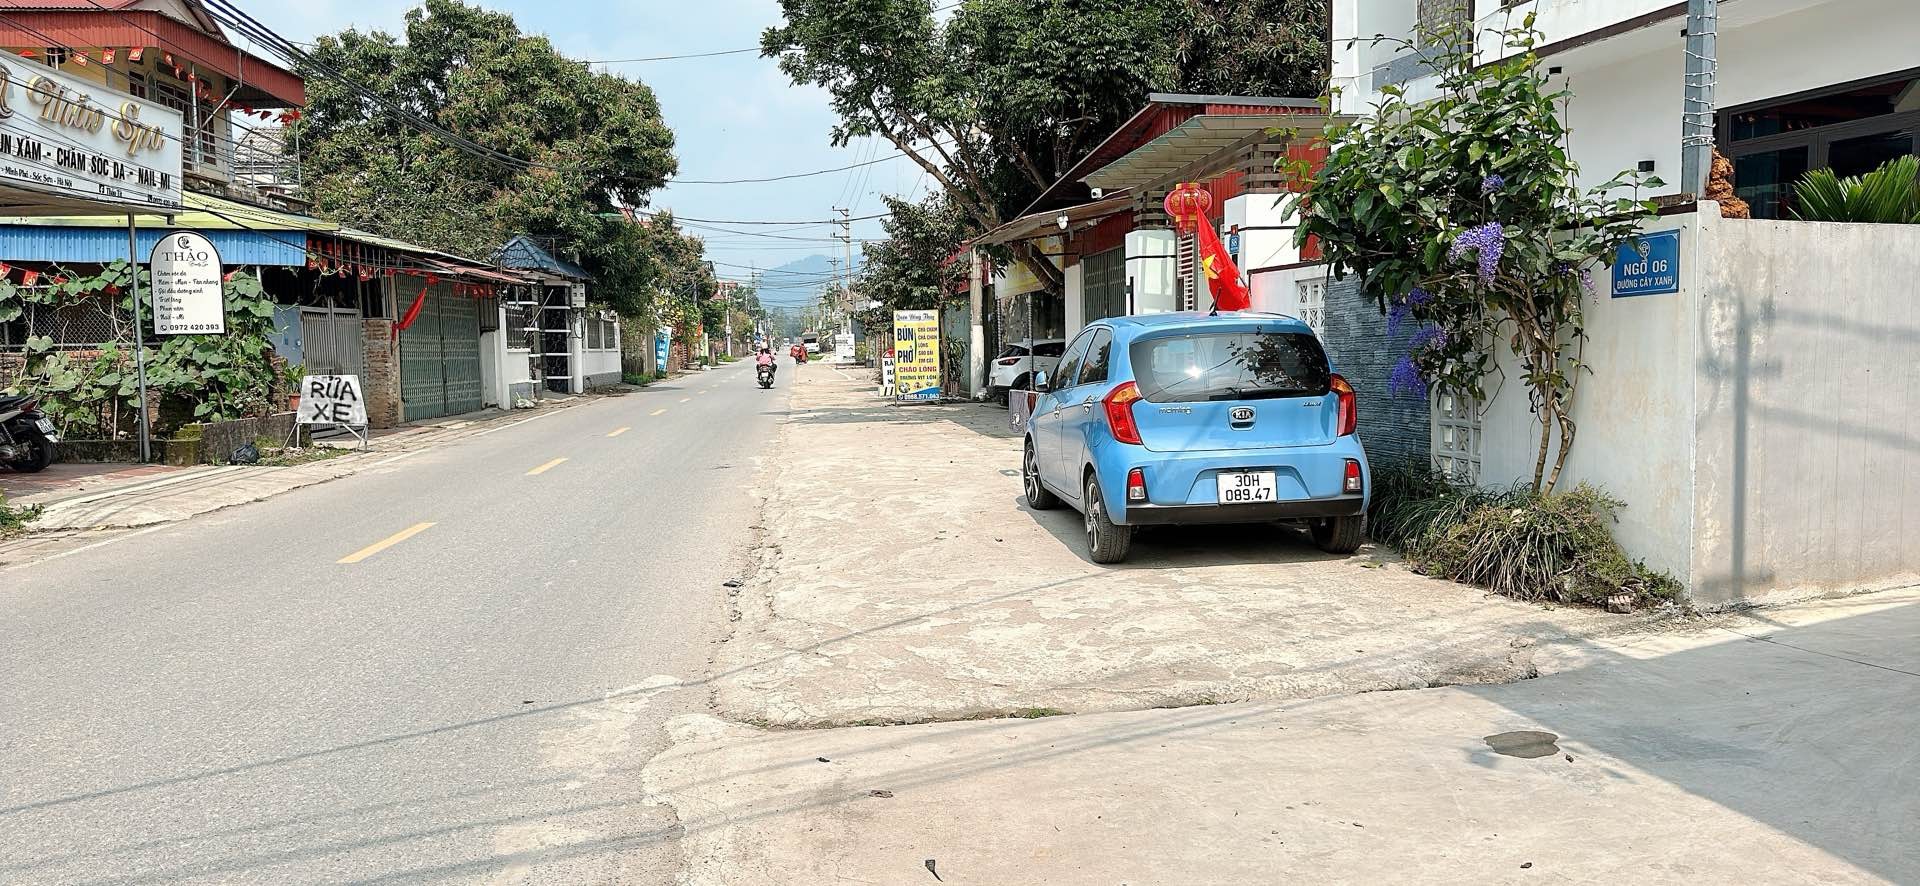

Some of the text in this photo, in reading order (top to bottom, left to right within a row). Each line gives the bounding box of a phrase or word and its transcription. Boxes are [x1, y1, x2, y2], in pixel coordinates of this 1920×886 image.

[16, 136, 42, 161] XĂM
[56, 147, 86, 171] CHĂM
[90, 153, 109, 176] SÓC
[113, 161, 125, 180] DA
[138, 167, 157, 187] NAIL
[160, 172, 171, 190] MI
[162, 249, 208, 261] THẢO
[1623, 259, 1668, 276] NGÕ 06
[1616, 275, 1673, 290] ĐƯỜNG CÂY XANH
[897, 325, 914, 342] BÚN
[897, 345, 914, 364] PHỞ
[312, 402, 352, 422] XE
[1159, 406, 1192, 415] morning
[1234, 409, 1252, 419] KIA
[1234, 474, 1260, 487] 30H
[1225, 487, 1271, 501] 089.47
